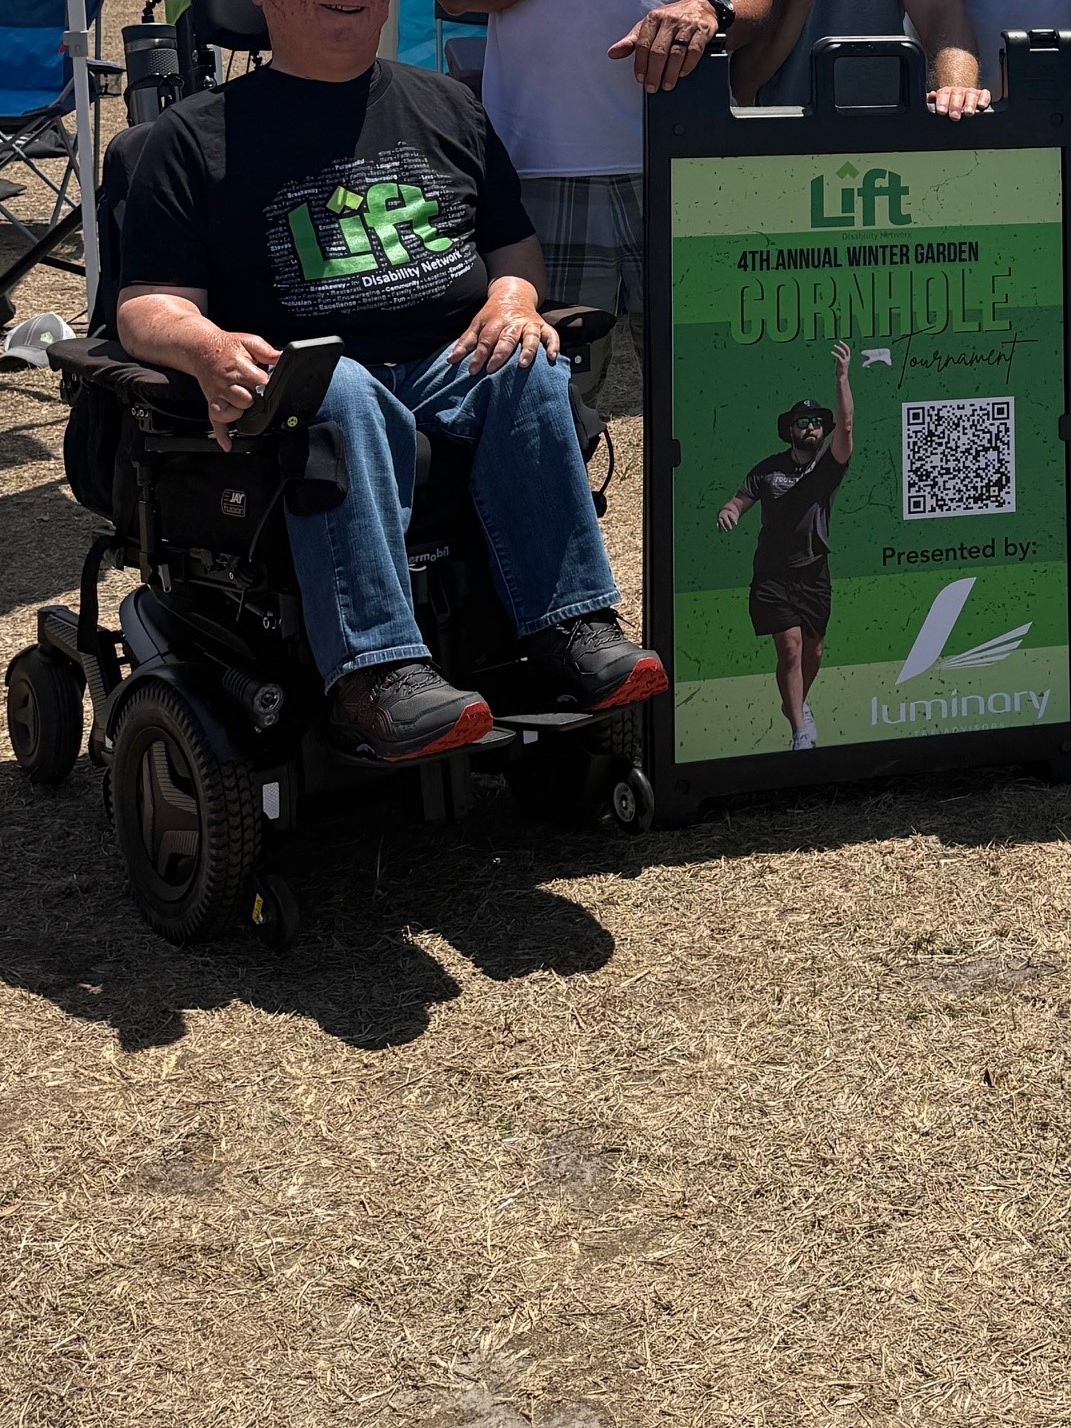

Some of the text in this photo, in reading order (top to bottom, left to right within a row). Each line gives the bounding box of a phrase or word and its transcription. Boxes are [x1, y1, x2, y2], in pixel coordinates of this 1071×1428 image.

[810, 160, 913, 229] Lift
[288, 182, 454, 281] Lift
[737, 241, 979, 272] 4TH ANNUAL WINTER GARDEN
[362, 266, 420, 287] Disability
[420, 248, 463, 273] Network
[729, 267, 1013, 346] CORNHOLE
[891, 324, 1039, 391] Tournament
[882, 537, 1037, 567] Presented by:
[871, 688, 1051, 726] luminary
